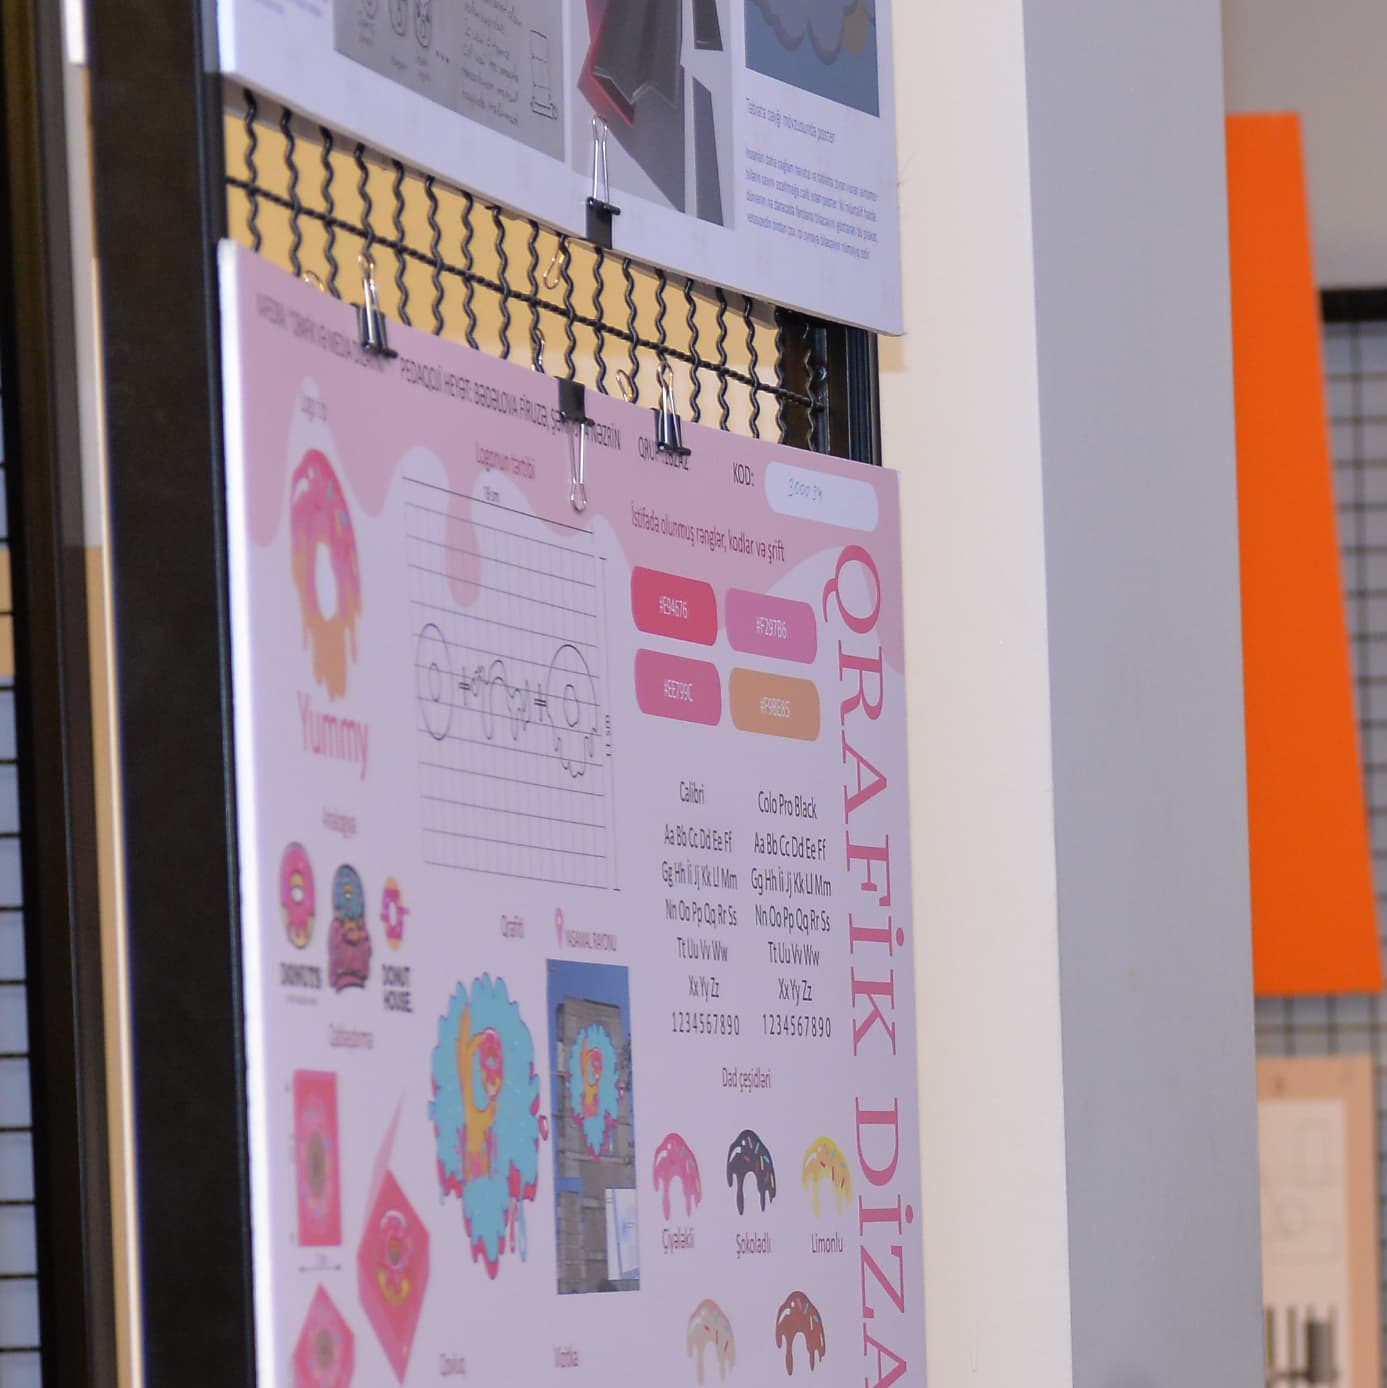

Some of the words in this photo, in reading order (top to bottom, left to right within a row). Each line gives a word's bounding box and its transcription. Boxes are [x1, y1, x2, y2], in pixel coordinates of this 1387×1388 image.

[680, 780, 704, 805] Calibri
[779, 794, 793, 818] Pro
[794, 796, 817, 820] Black
[754, 832, 765, 855] Aa
[767, 833, 778, 856] Bb
[779, 835, 790, 858] Cc
[792, 836, 804, 860] Dd
[806, 838, 816, 861] Ee
[817, 838, 826, 862] Ff
[755, 904, 768, 928] Nn
[769, 905, 782, 929] Oo
[783, 907, 795, 934] Pp
[796, 908, 809, 936] Qq
[810, 909, 820, 932] Rr
[820, 910, 831, 933] Ss
[768, 941, 777, 965] Tt
[778, 943, 791, 966] Uu
[792, 944, 803, 967] Vv
[803, 945, 820, 968] Ww
[688, 975, 699, 998] Xx
[700, 975, 709, 1003] Yy
[711, 977, 720, 999] Zz
[778, 978, 789, 1001] Xx
[790, 979, 801, 1007] Yy
[801, 980, 813, 1002] Zz
[762, 1013, 832, 1039] 1234567890
[722, 1066, 738, 1089] Dad
